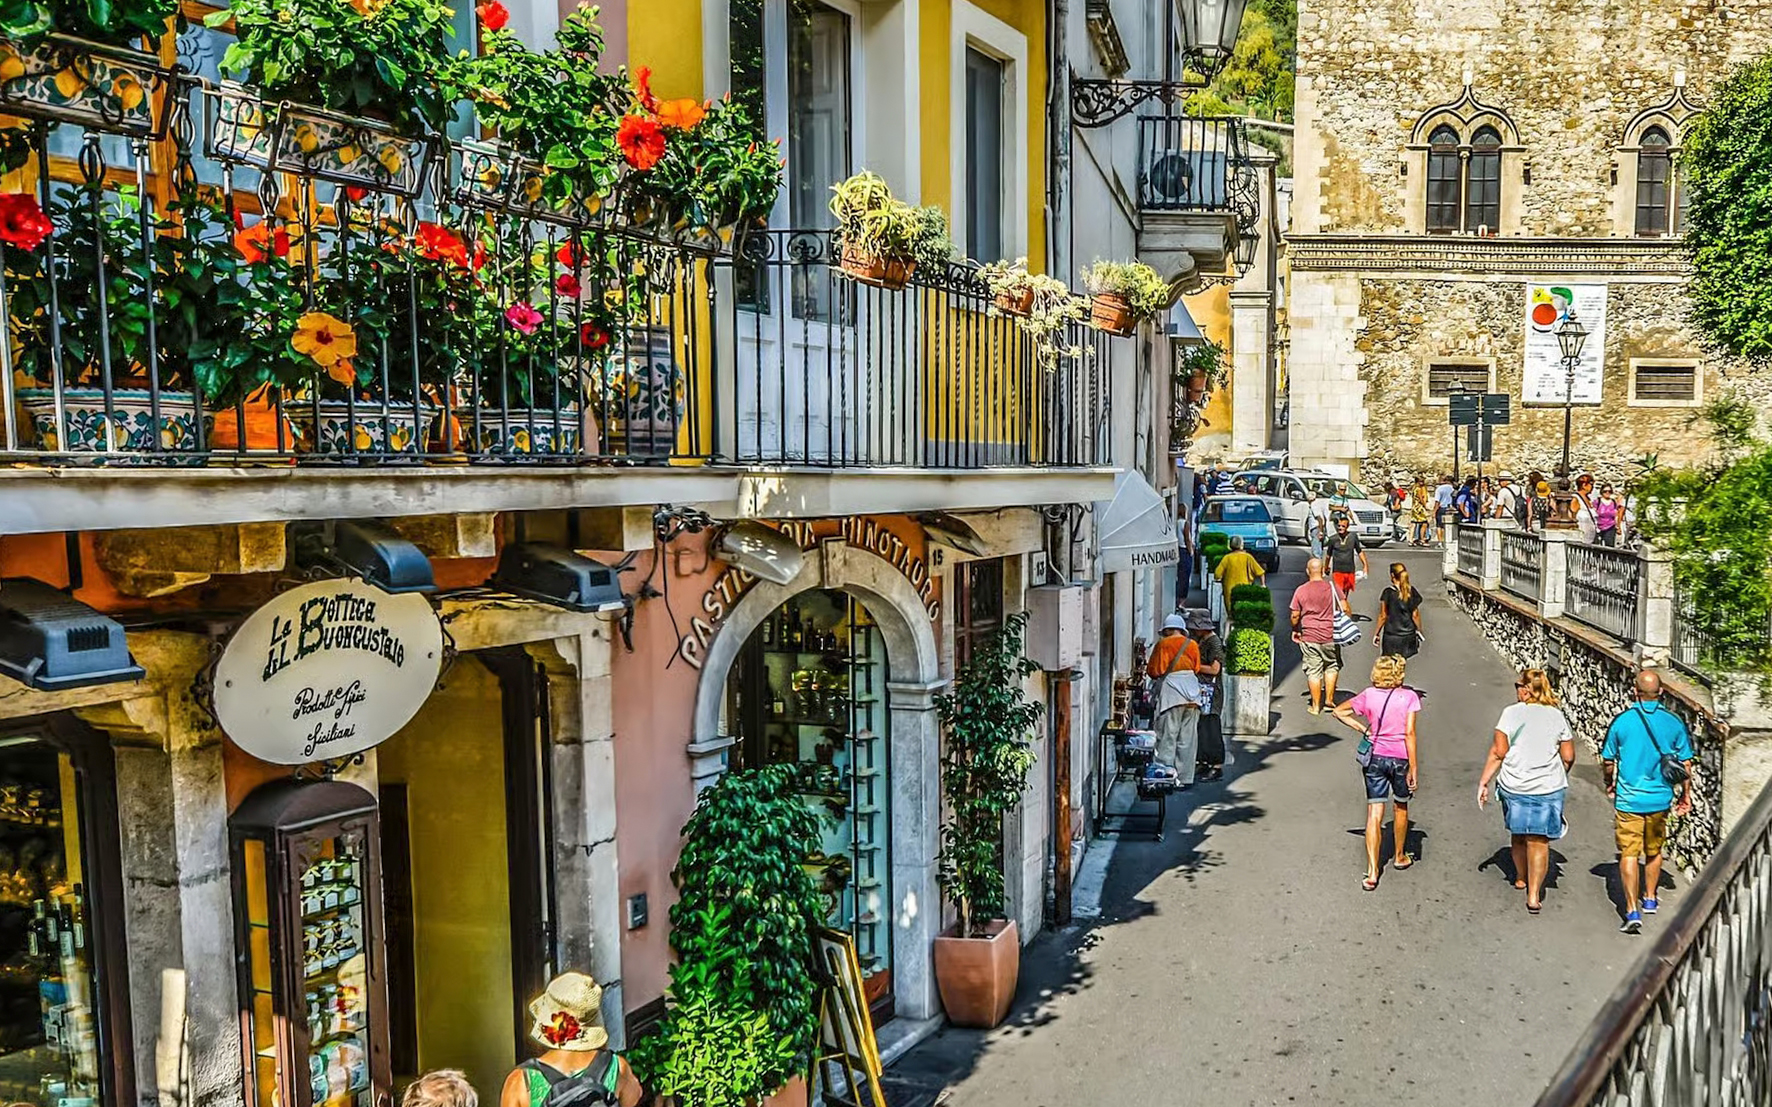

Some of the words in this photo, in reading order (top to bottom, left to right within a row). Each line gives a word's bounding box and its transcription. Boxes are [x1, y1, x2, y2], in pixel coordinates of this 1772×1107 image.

[932, 549, 943, 566] 15
[1036, 561, 1045, 577] 13
[270, 615, 292, 647] La
[293, 687, 336, 720] Prodotti
[304, 722, 356, 757] Siciliani
